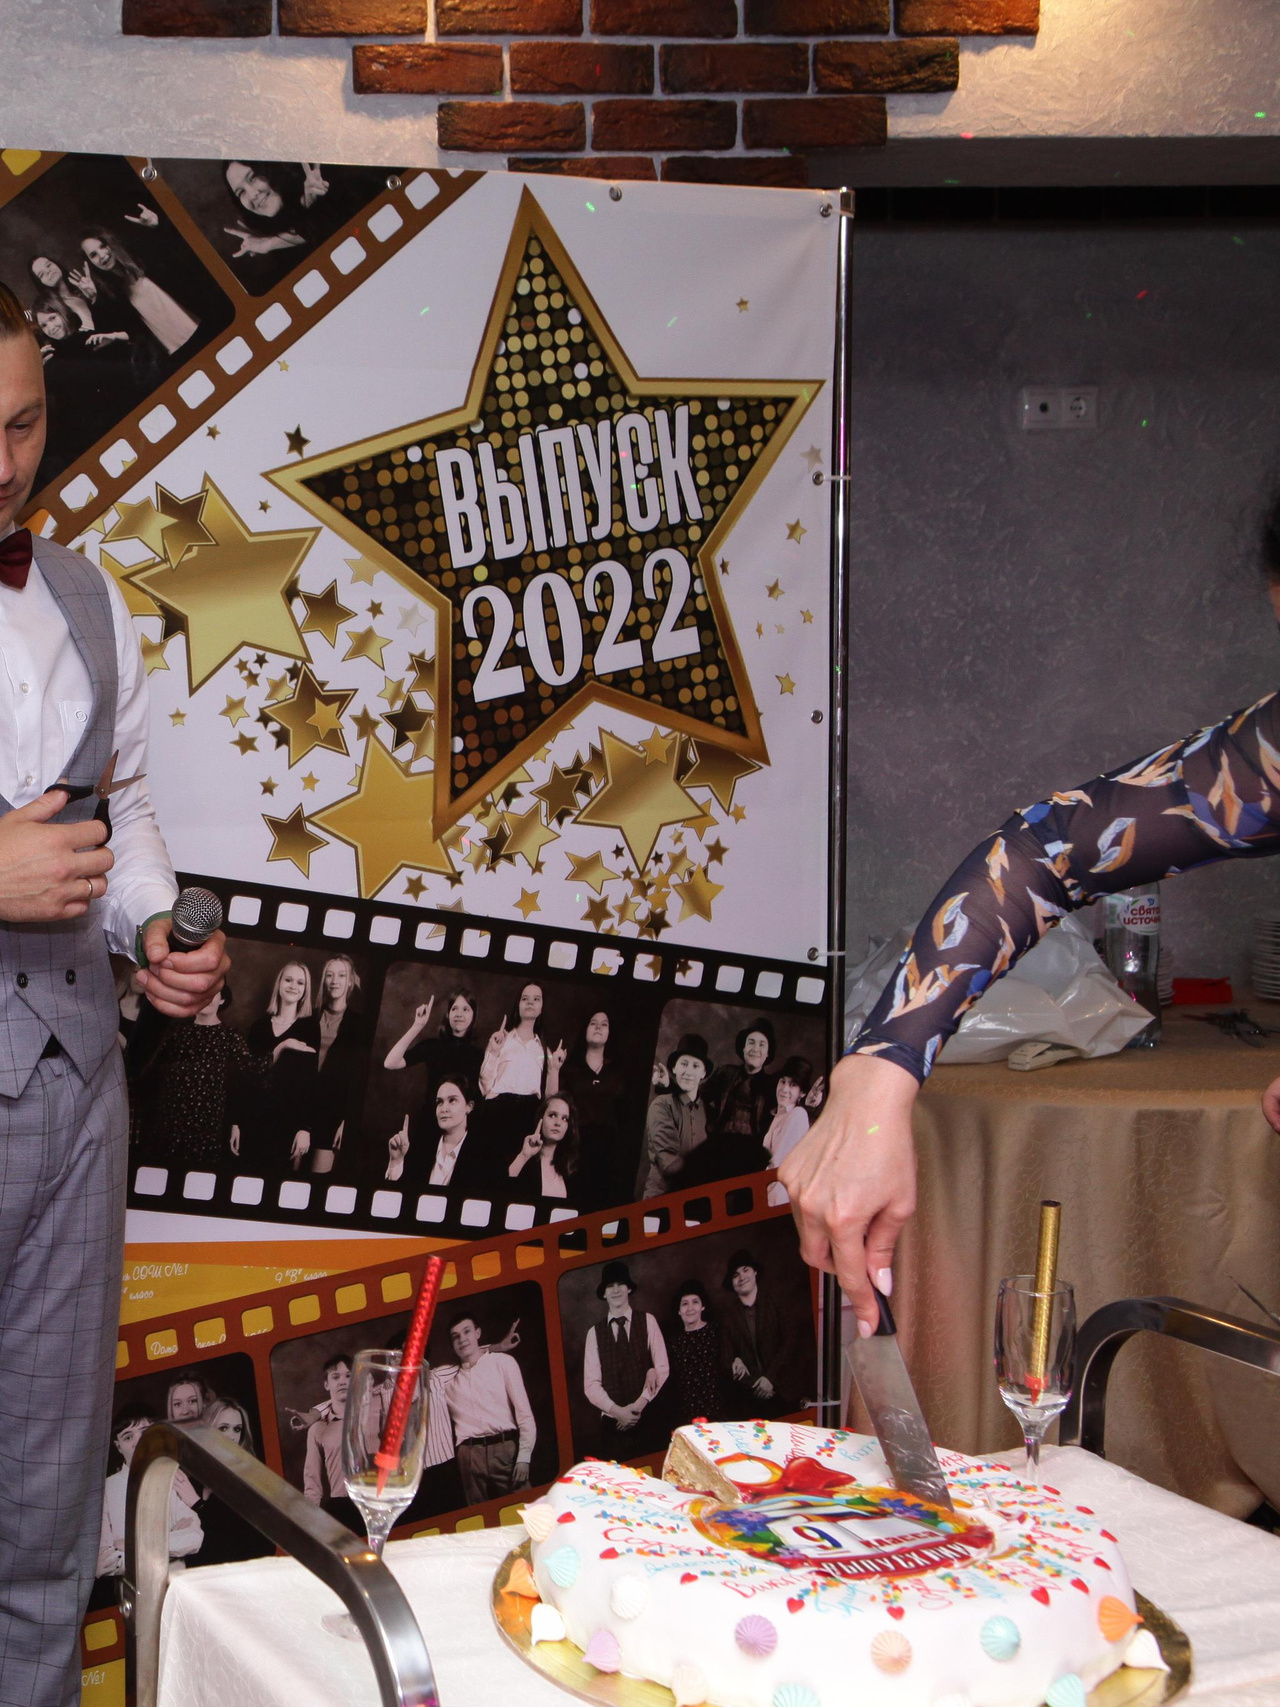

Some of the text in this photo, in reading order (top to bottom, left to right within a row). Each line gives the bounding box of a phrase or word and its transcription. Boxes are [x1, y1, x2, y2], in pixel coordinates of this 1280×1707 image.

[434, 403, 705, 569] ВЫПУСК
[462, 547, 702, 703] 2022
[132, 1264, 162, 1280] СОШ
[792, 1525, 843, 1550] 9
